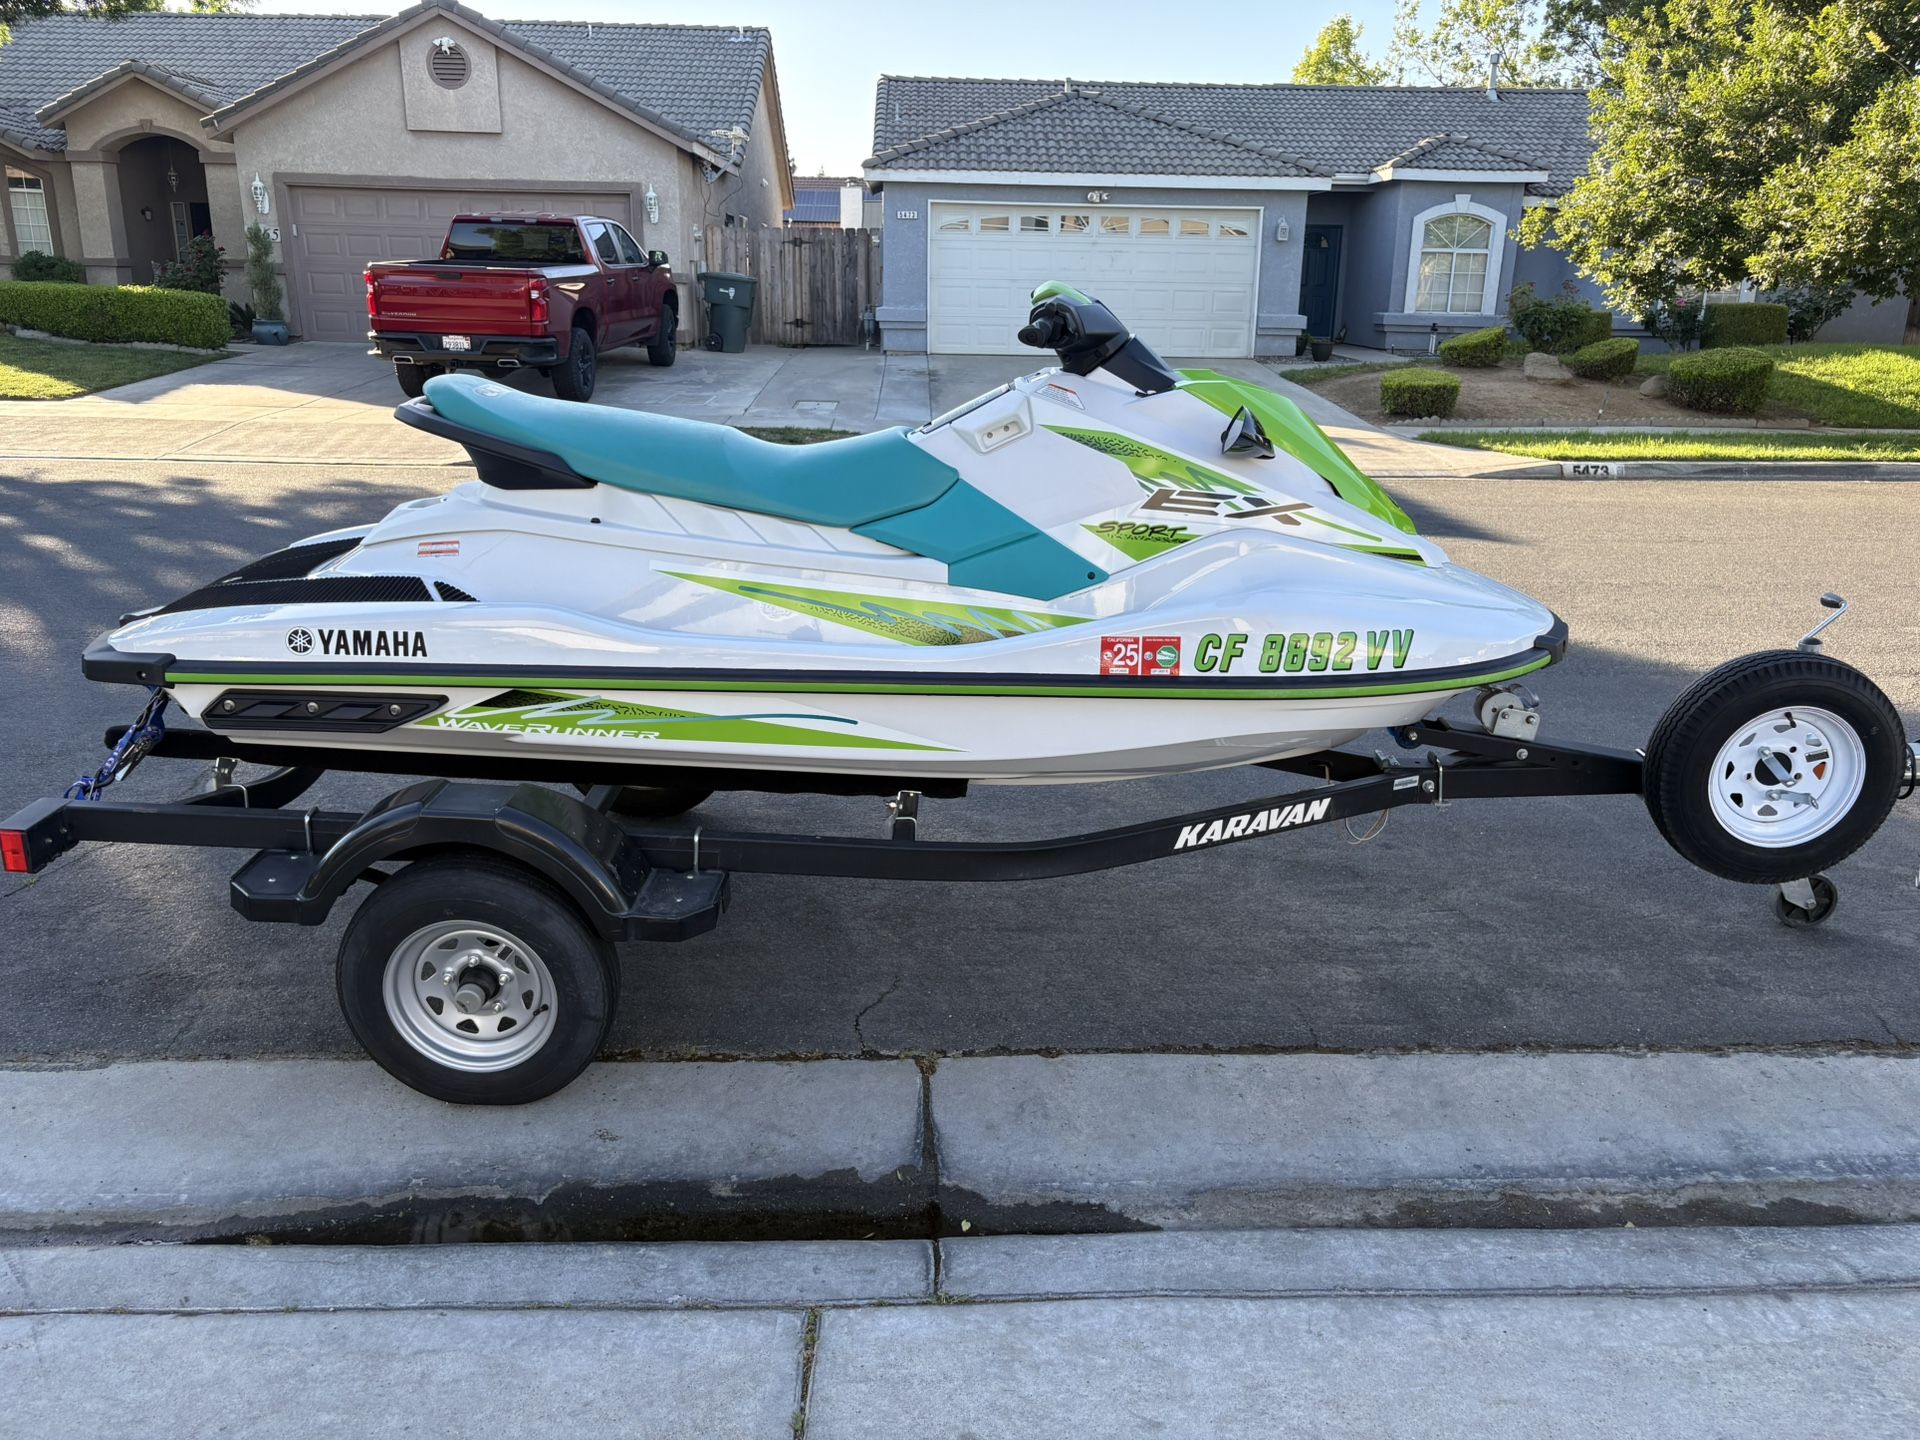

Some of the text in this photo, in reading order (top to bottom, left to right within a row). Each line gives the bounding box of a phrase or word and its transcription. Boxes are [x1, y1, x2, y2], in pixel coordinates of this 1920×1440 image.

[1573, 464, 1610, 477] 5473
[1140, 488, 1314, 526] EX
[1096, 520, 1188, 539] SPORT
[317, 628, 428, 657] YAMAHA
[1112, 643, 1138, 667] 25
[1194, 628, 1414, 673] CF 8892 VV
[1173, 797, 1332, 850] KARAVAN
